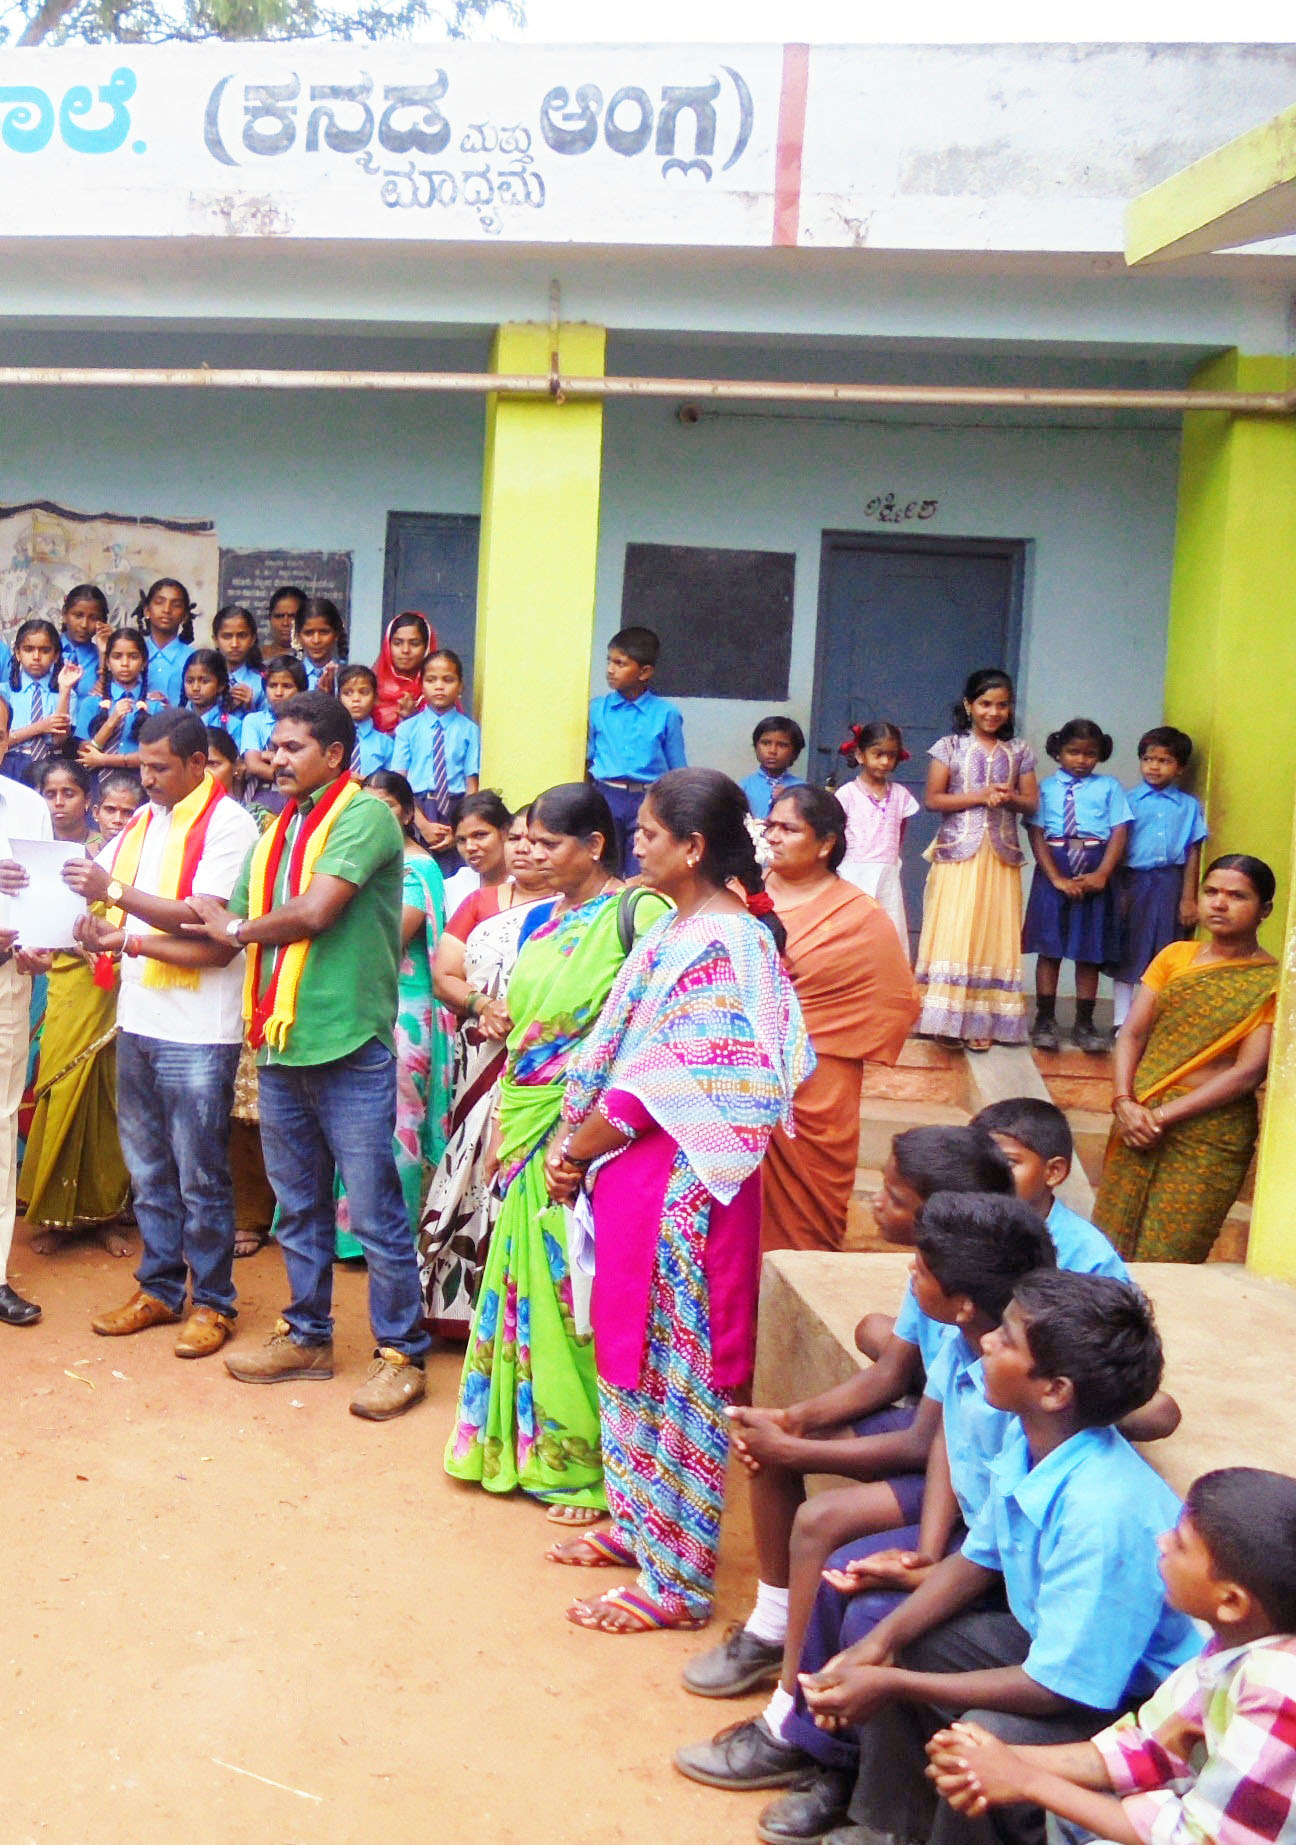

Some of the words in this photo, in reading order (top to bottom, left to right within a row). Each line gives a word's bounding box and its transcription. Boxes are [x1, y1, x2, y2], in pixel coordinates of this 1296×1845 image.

[204, 68, 451, 173] (ಕನ್ನಡ
[460, 120, 535, 165] ಮತ್ತು
[380, 162, 546, 235] ಮಾಧ್ಯಮ
